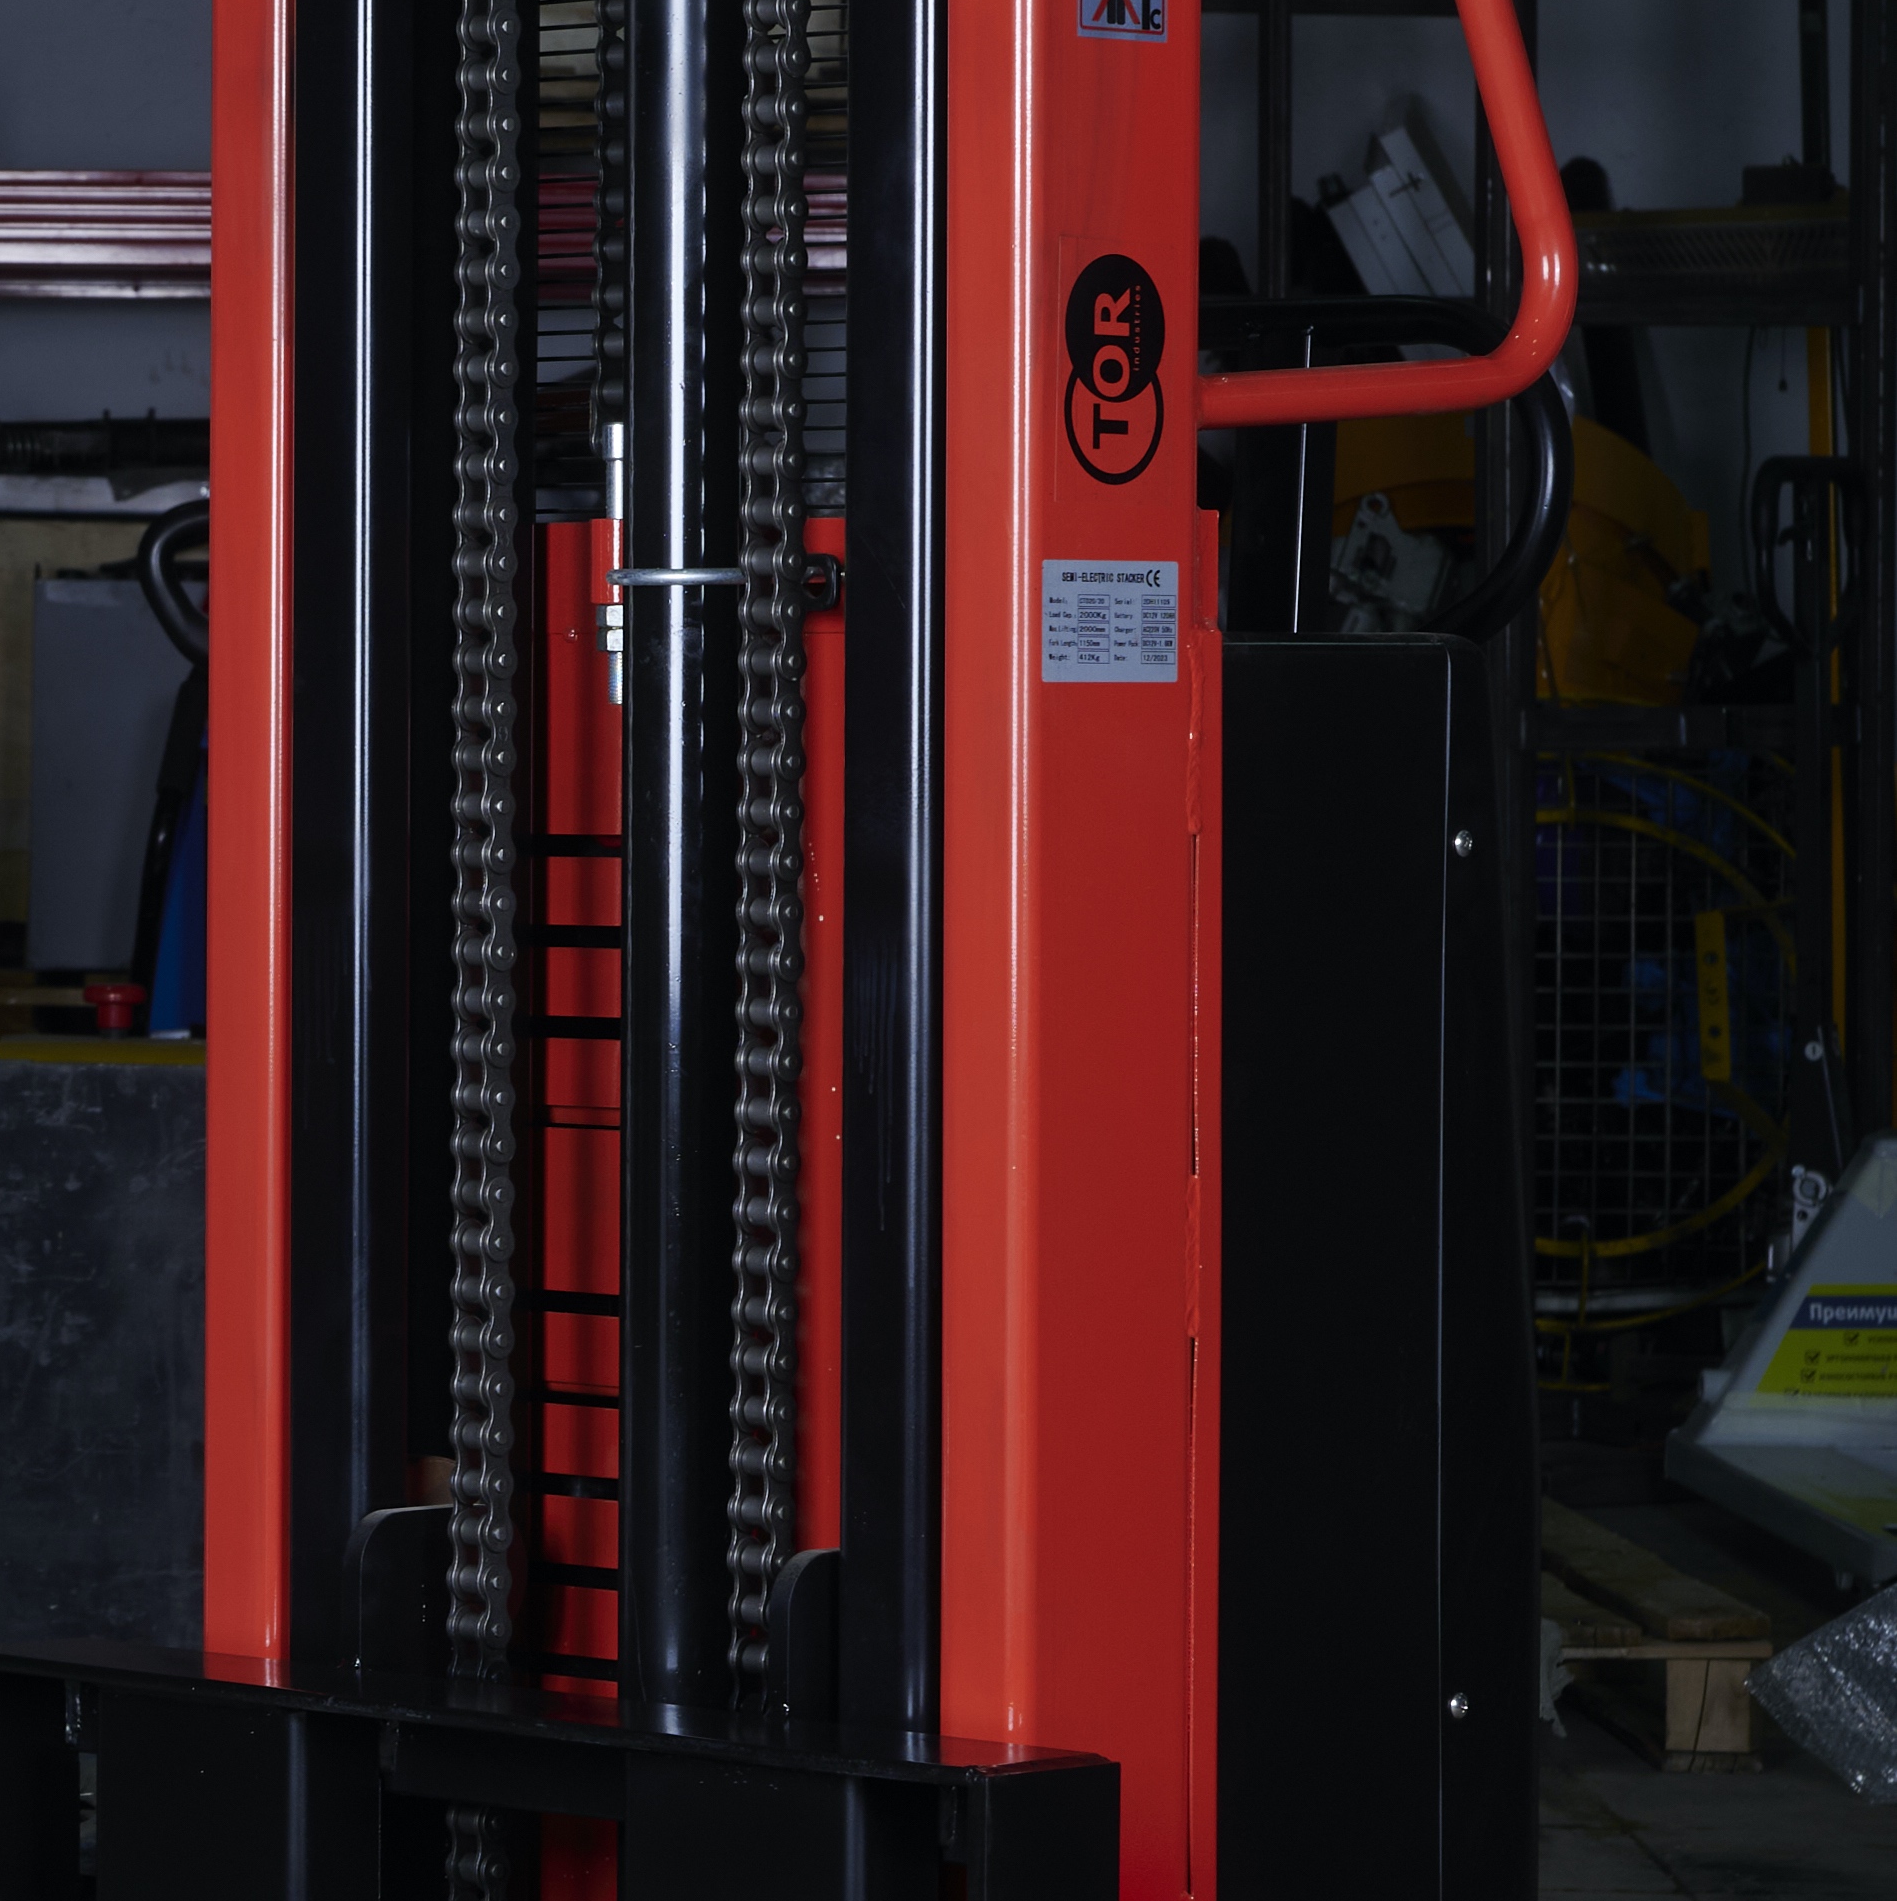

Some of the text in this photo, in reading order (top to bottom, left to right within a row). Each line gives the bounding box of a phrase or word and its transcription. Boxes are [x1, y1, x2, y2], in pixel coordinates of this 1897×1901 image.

[1092, 287, 1131, 449] TOR
[1132, 284, 1142, 371] industries
[1062, 572, 1113, 583] SEMI-ELECTRIC
[1116, 573, 1144, 583] STACKER
